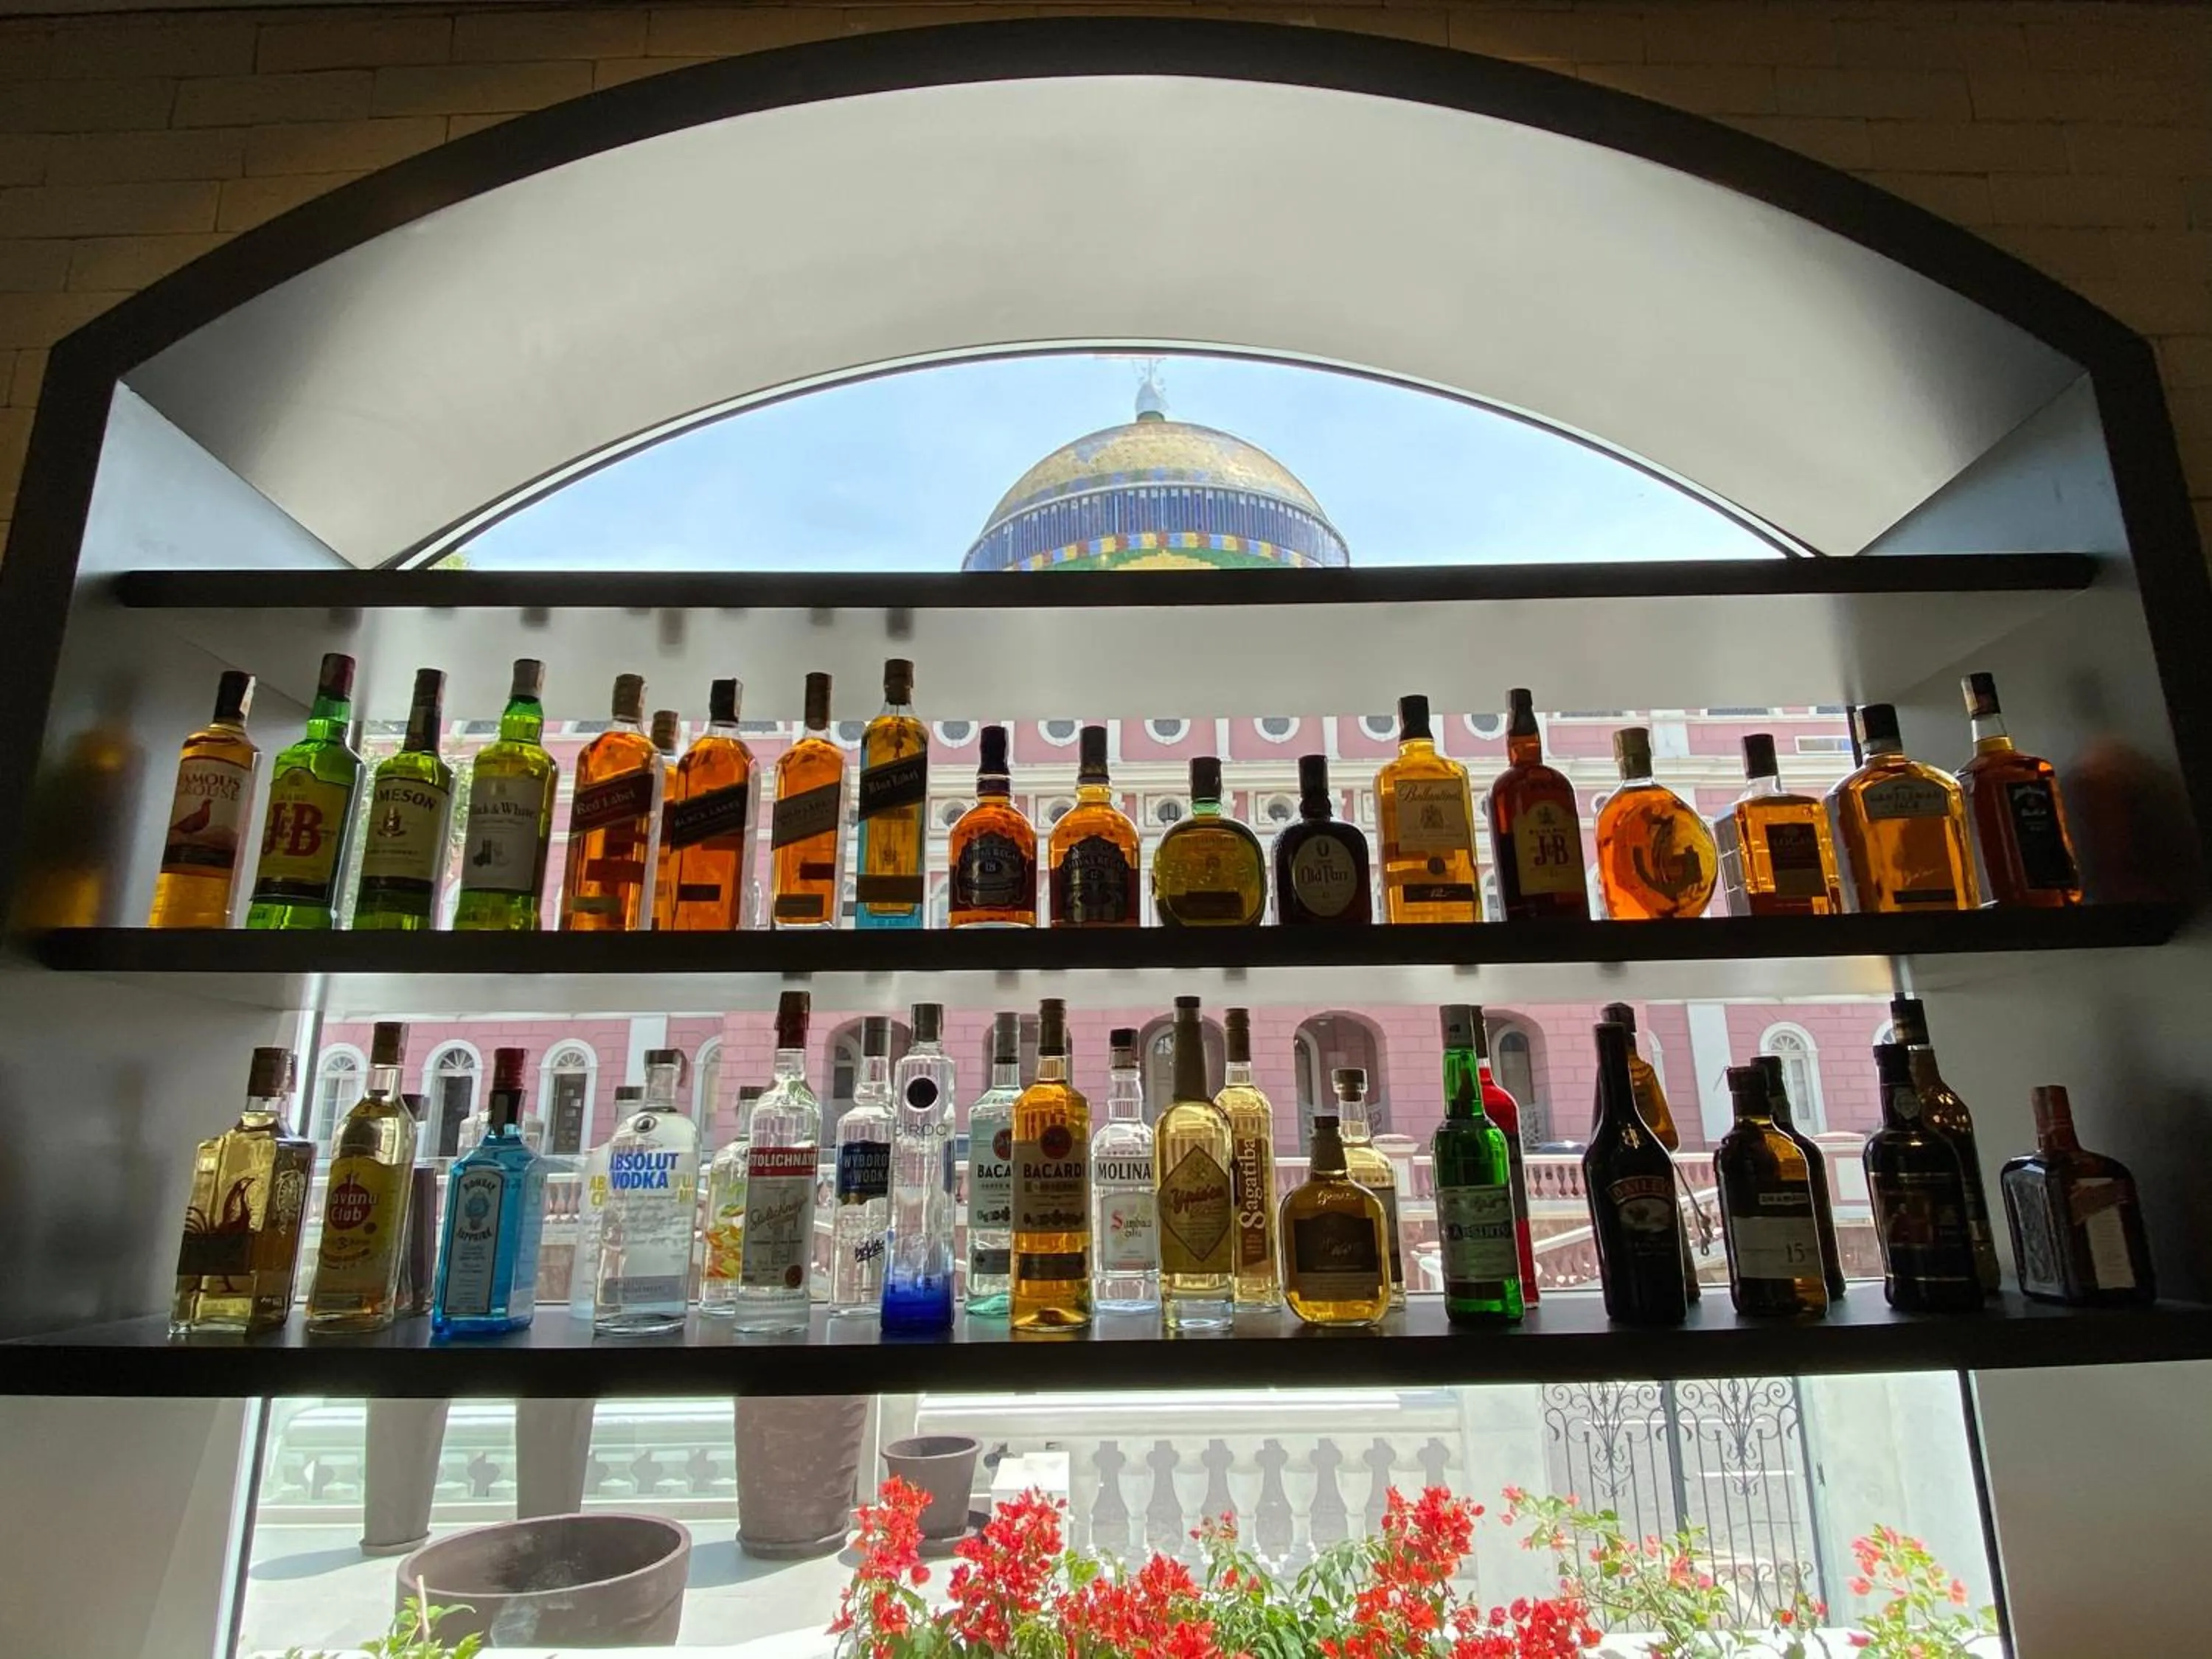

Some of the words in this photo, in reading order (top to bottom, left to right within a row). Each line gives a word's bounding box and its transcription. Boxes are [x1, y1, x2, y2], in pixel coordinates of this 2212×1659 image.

[183, 773, 241, 792] AMOUS
[184, 785, 239, 801] ROUSE
[602, 789, 636, 808] Label
[844, 1152, 888, 1169] WYBORO
[978, 1163, 1012, 1179] BACA
[1099, 1162, 1154, 1180] MOLINA
[611, 1172, 669, 1189] VODKA
[1237, 1138, 1266, 1230] Sagatiba
[330, 1206, 362, 1222] Club
[1785, 1242, 1806, 1263] 15
